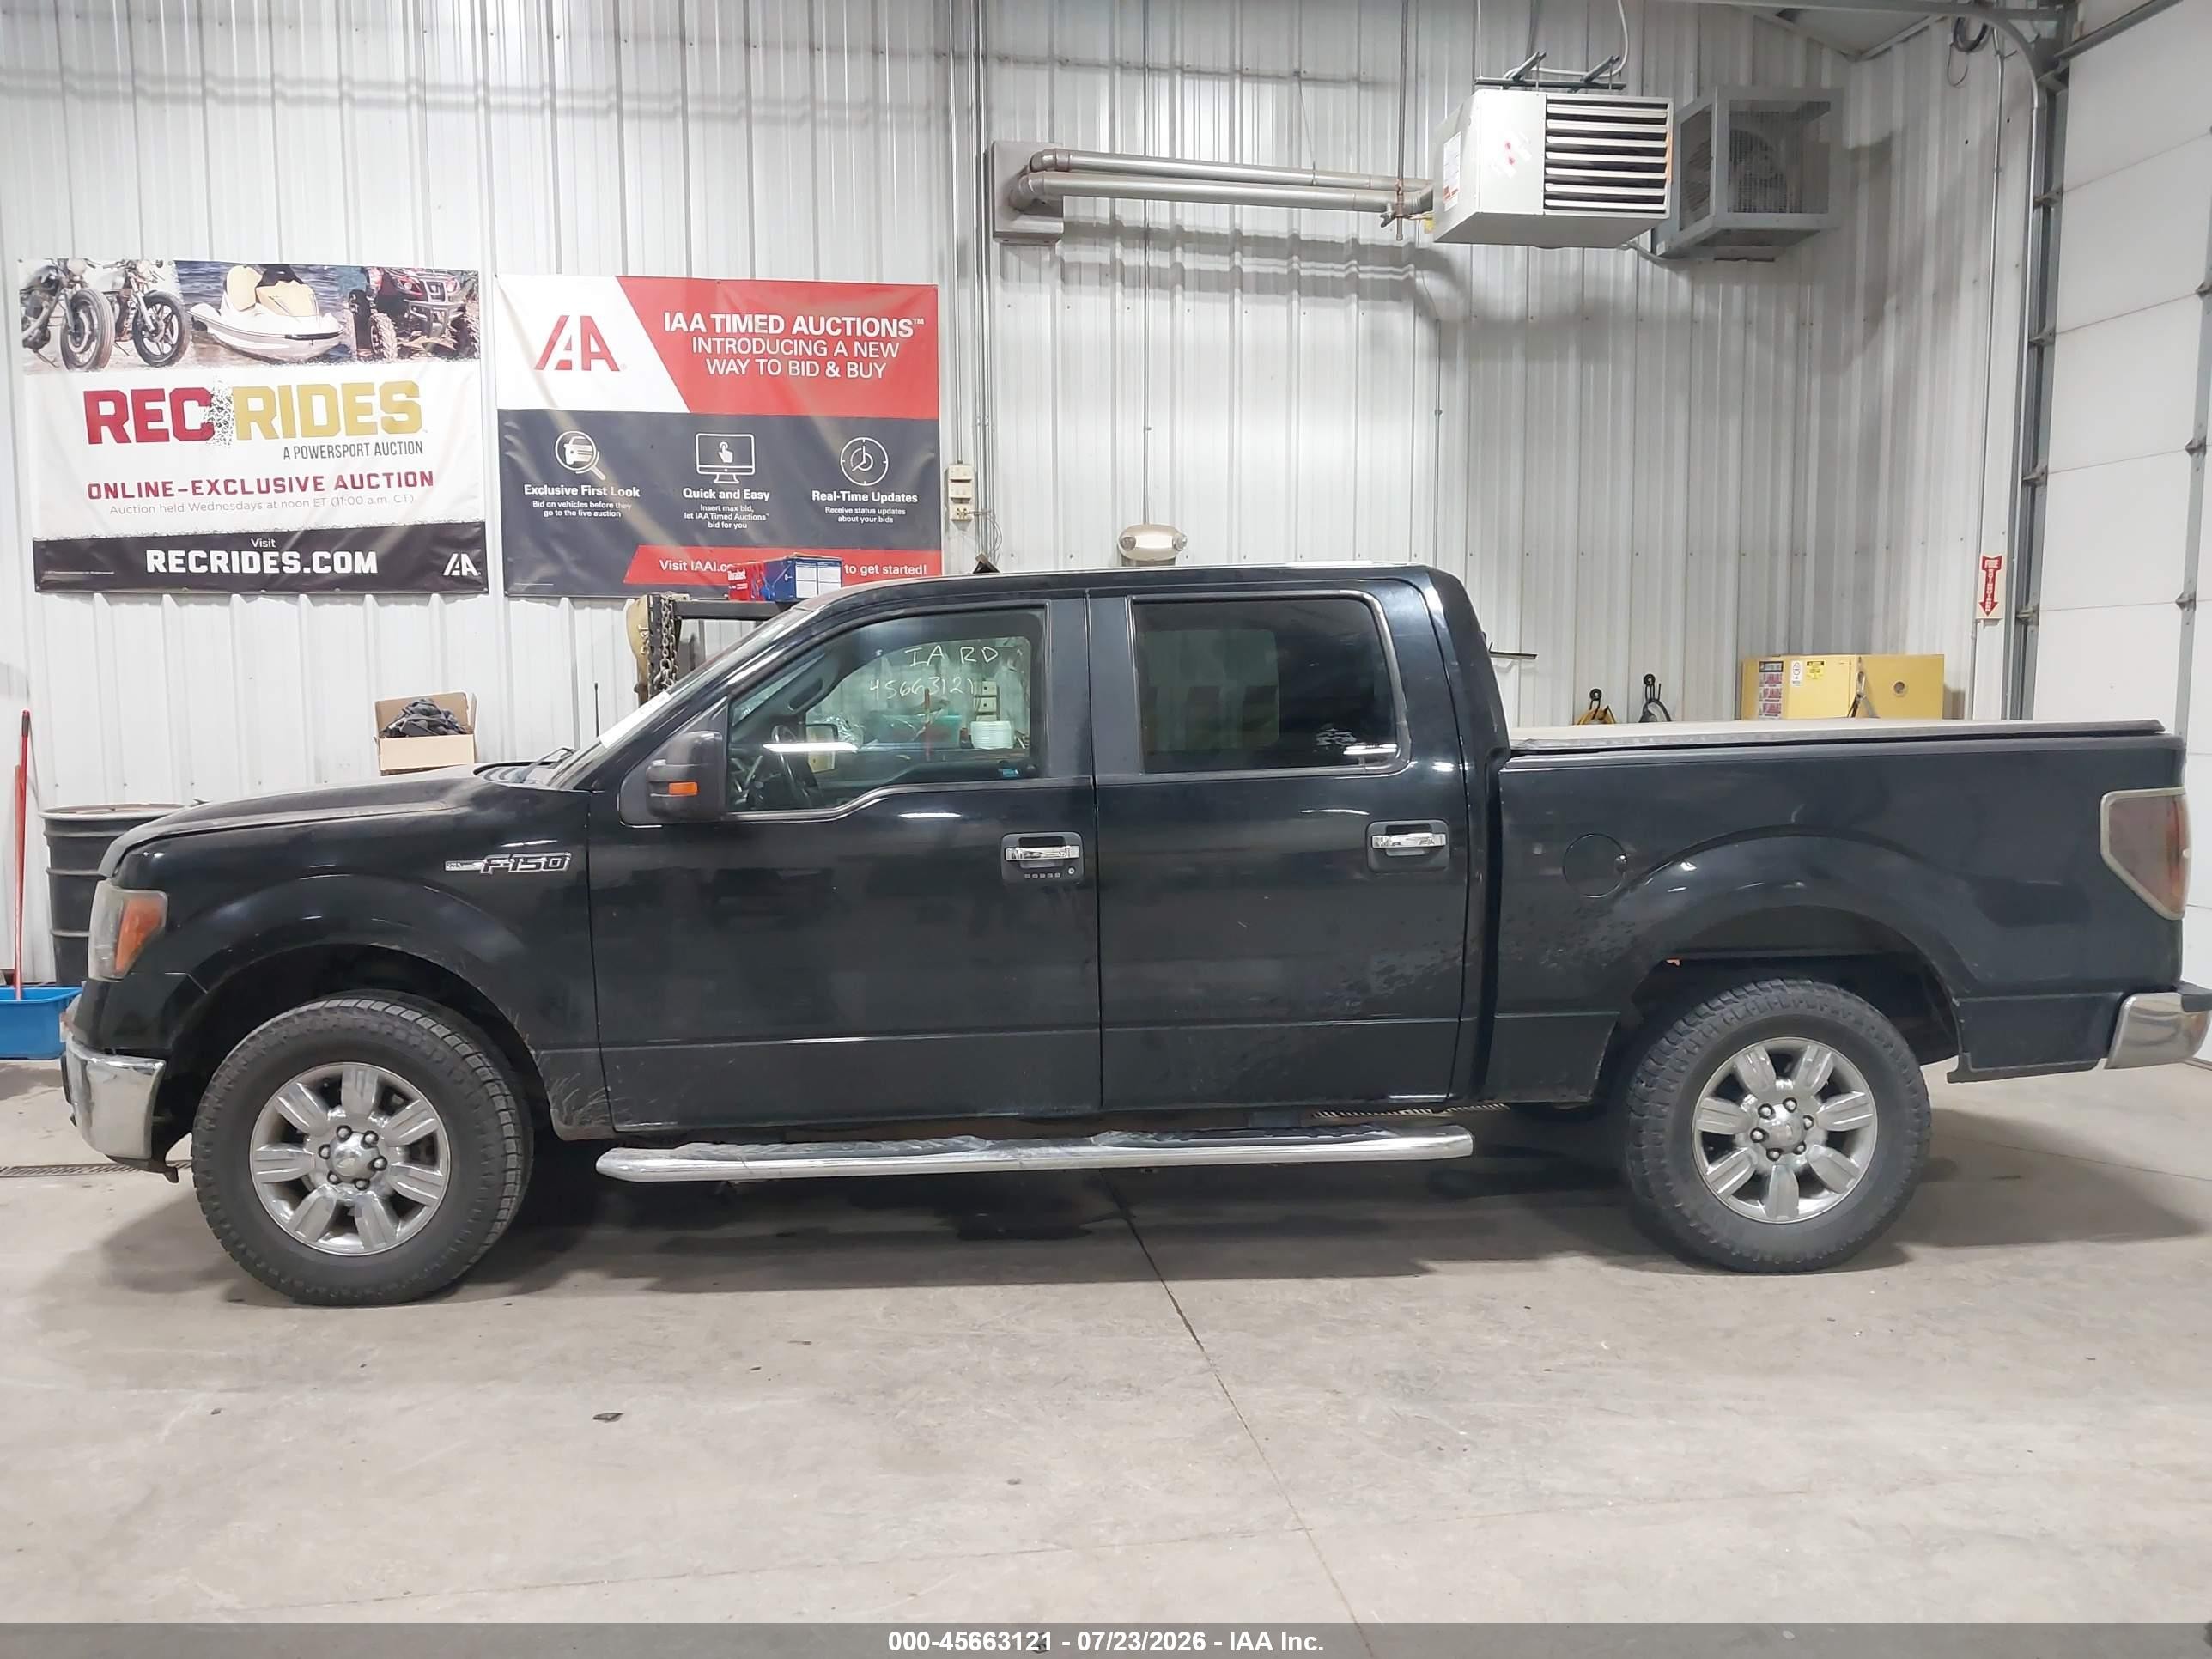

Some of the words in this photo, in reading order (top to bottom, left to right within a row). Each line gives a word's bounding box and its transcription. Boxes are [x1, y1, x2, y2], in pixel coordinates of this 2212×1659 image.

[664, 312, 707, 332] IAA
[710, 313, 785, 334] TIMED
[692, 337, 828, 357] INTRODUCING
[833, 343, 848, 357] A
[854, 342, 900, 358] NEW
[706, 358, 750, 376] WAY
[755, 358, 782, 376] TO
[788, 360, 820, 377] BID
[825, 362, 841, 378] &
[847, 362, 887, 379] BUY
[83, 387, 215, 445] REC
[283, 446, 291, 461] A
[294, 442, 370, 459] POWERSPORT
[374, 441, 423, 456] AUCTION
[87, 475, 325, 501] ONLINE-EXCLUSIVE
[334, 470, 434, 491] AUCTION
[524, 483, 579, 495] Exclusive
[580, 484, 608, 496] First
[611, 486, 641, 497] Look
[683, 488, 716, 499] Quick
[719, 489, 740, 500] and
[743, 489, 770, 502] Easy
[109, 504, 156, 515] Auction
[160, 503, 185, 514] held
[188, 500, 263, 513] Wednesdays
[313, 498, 329, 507] ET
[331, 495, 364, 508] (11:00
[615, 502, 632, 511] they
[811, 490, 869, 502] Real-Time
[872, 491, 919, 504] Updates
[824, 506, 854, 514] Receive
[854, 507, 876, 515] status
[878, 507, 906, 516] updates
[860, 516, 877, 525] your
[251, 538, 276, 548] Visit
[145, 550, 379, 574] RECRIDES.COM
[659, 559, 687, 572] Visit
[844, 563, 857, 574] to
[860, 564, 880, 577] get
[883, 563, 927, 575] started!
[868, 676, 975, 701] 45663121
